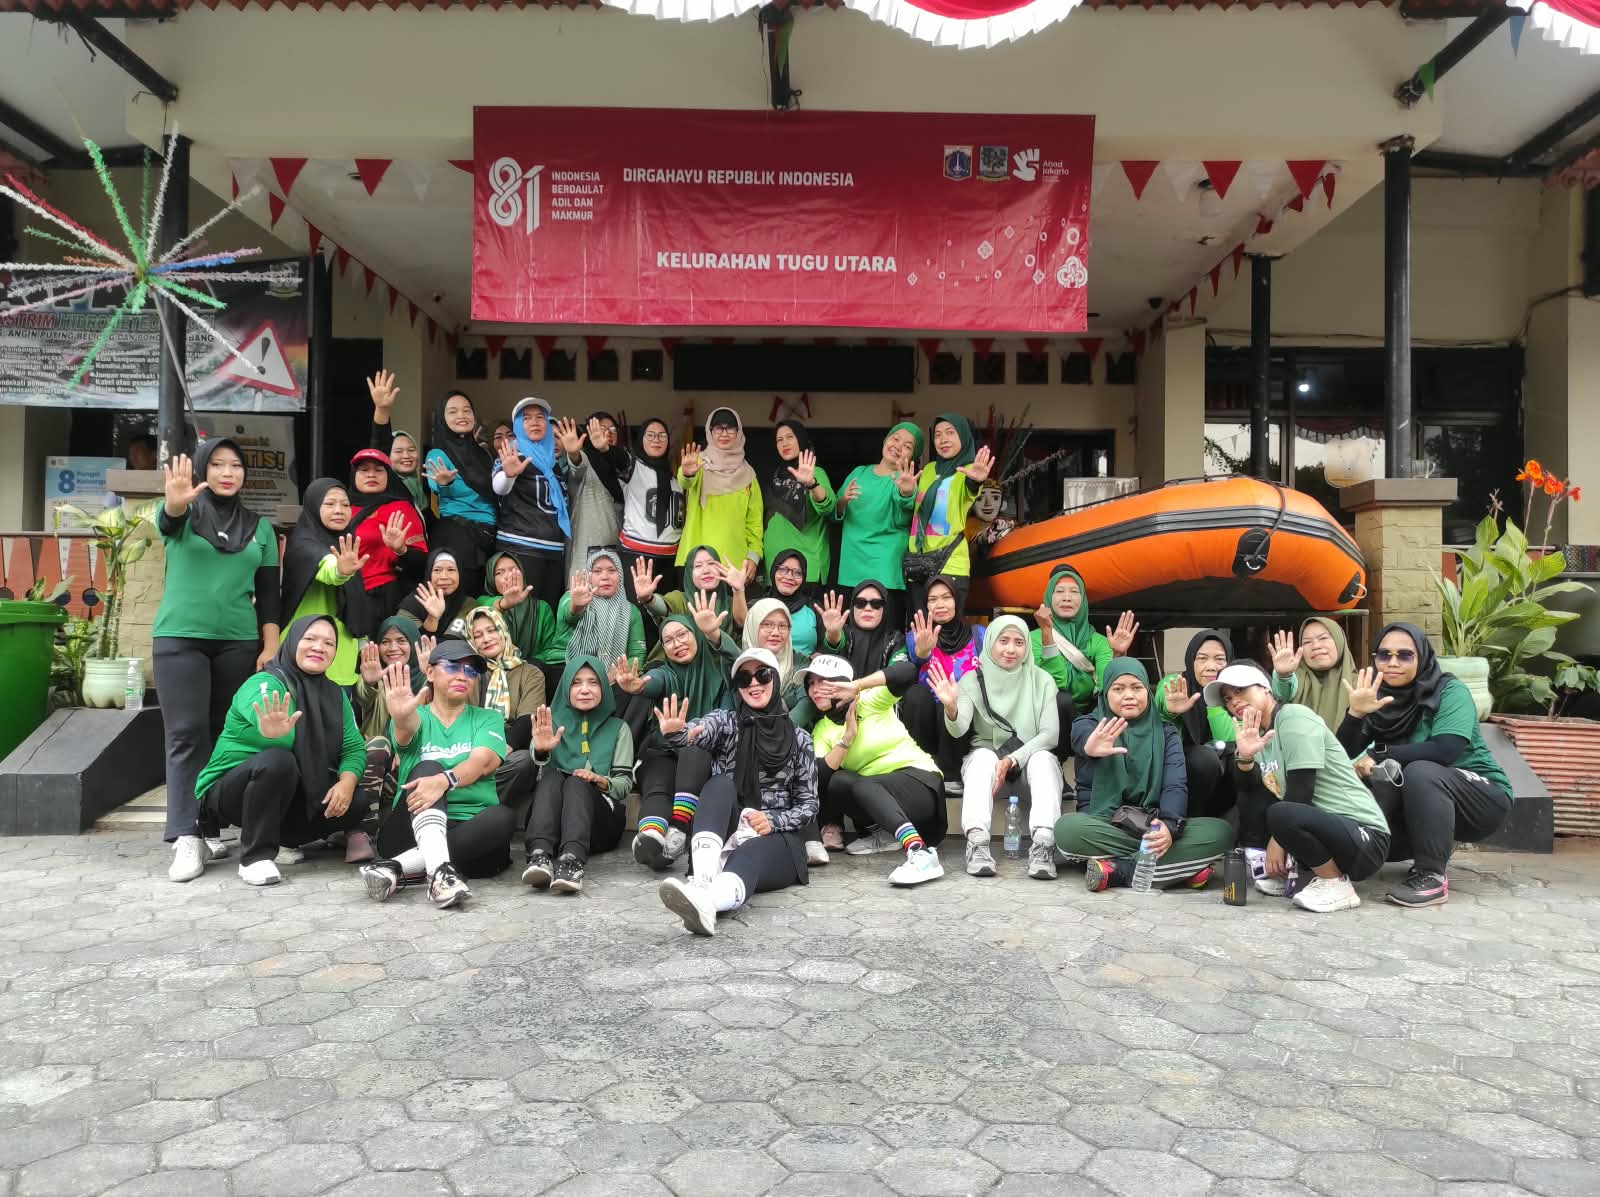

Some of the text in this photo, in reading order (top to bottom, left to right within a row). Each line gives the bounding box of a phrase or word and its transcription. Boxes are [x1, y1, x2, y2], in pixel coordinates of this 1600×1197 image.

[551, 171, 601, 182] INDONESIA
[623, 167, 855, 187] DIRGAHAYU REPUBLIK INDONESIA
[551, 184, 605, 195] BERDAULAT
[488, 156, 546, 236] 81
[551, 197, 593, 207] ADIL DAN
[551, 210, 593, 221] MAKMUR
[656, 251, 898, 273] KELURAHAN TUGU UTARA
[8, 329, 38, 338] ANGIN
[40, 331, 75, 340] PUTING
[58, 469, 76, 494] 8
